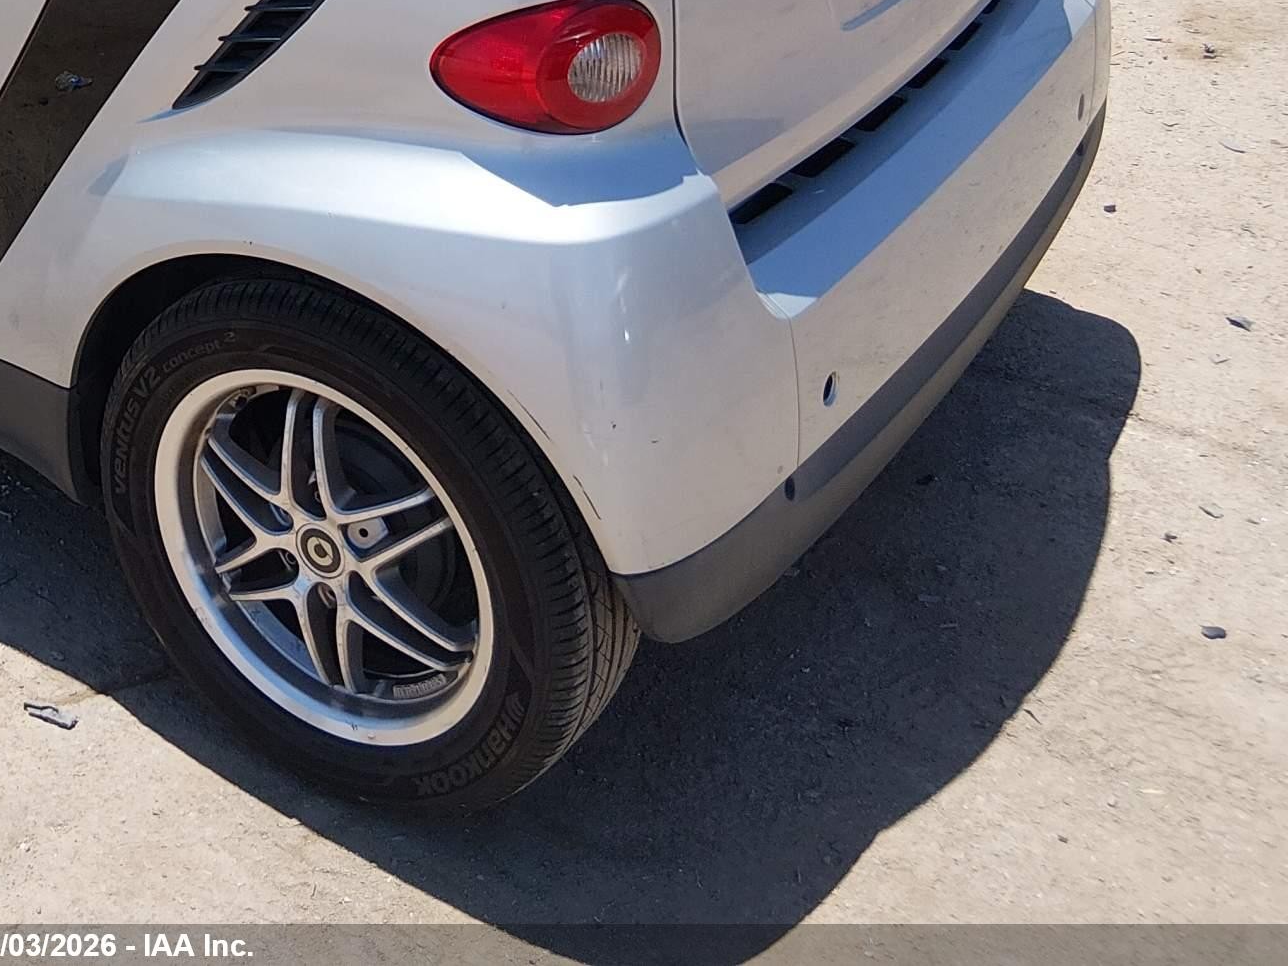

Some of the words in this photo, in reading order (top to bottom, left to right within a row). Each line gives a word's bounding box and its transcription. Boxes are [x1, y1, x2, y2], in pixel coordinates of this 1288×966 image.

[133, 366, 161, 398] V2
[163, 340, 220, 373] concept
[224, 331, 236, 343] 2
